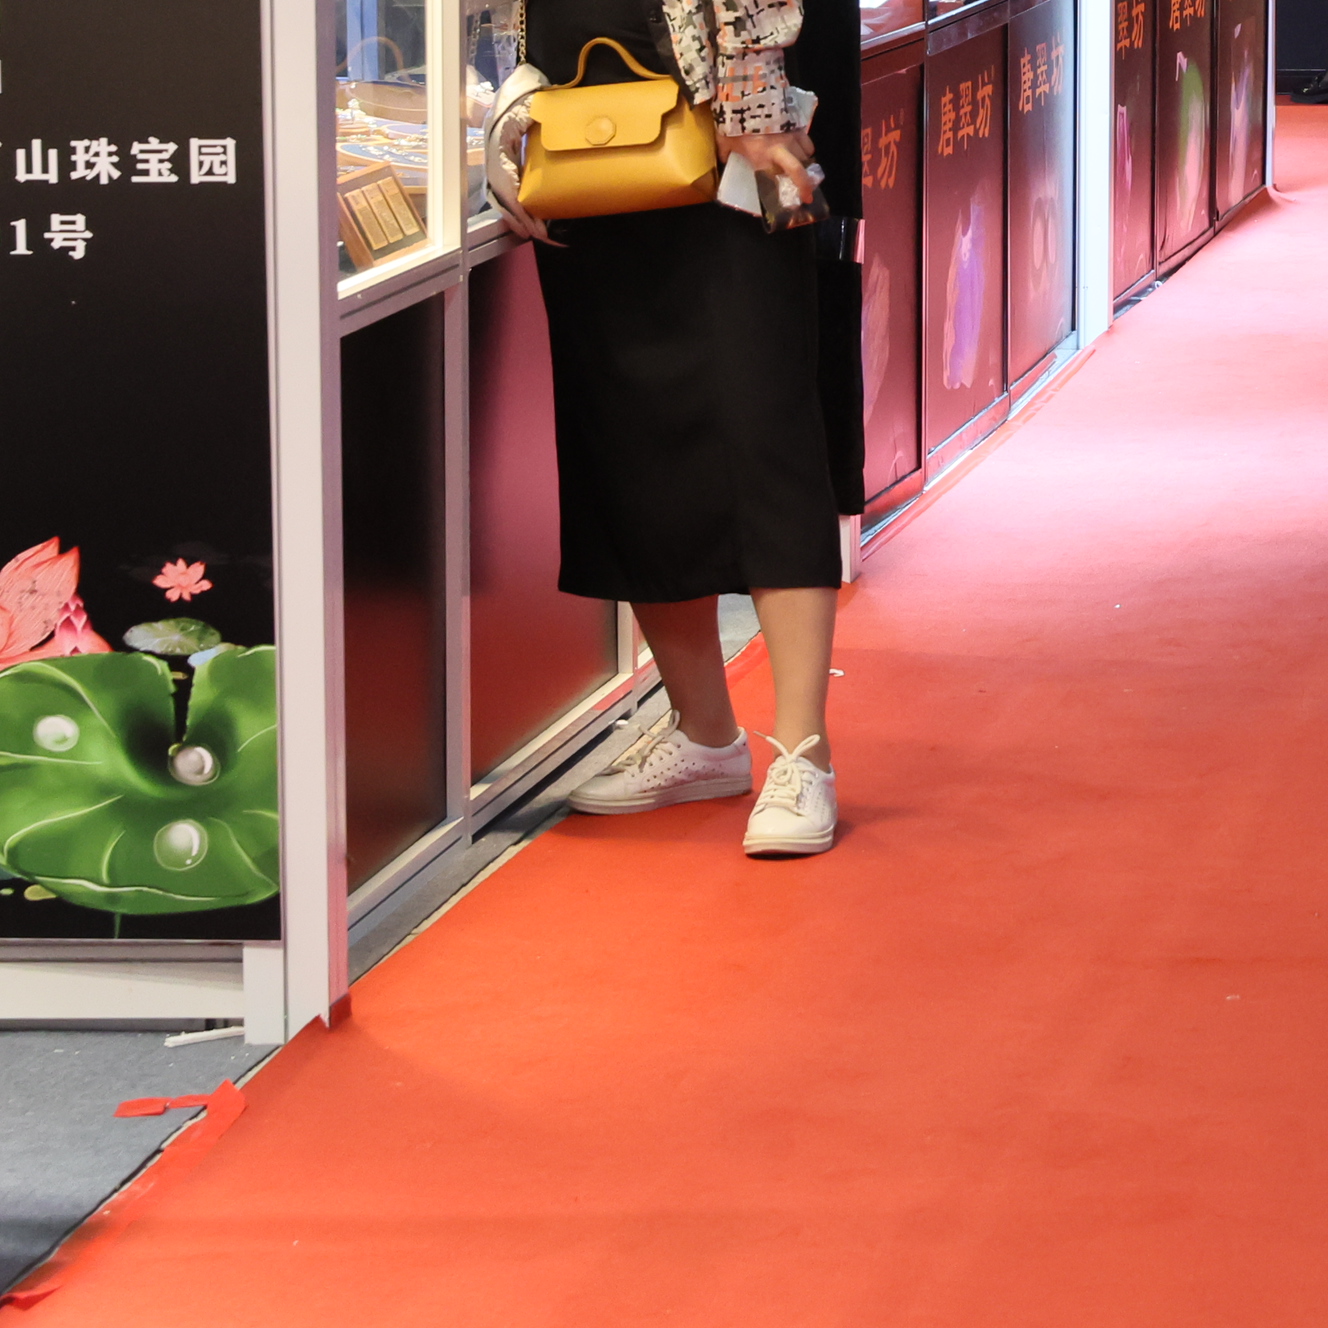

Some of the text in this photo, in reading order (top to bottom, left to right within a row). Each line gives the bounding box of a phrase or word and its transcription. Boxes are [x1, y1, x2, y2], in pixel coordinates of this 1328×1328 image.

[1018, 33, 1065, 115] 唐翠坊
[937, 69, 994, 157] 唐翠坊
[0, 136, 237, 185] 山珠宝园
[9, 213, 94, 260] 1号
